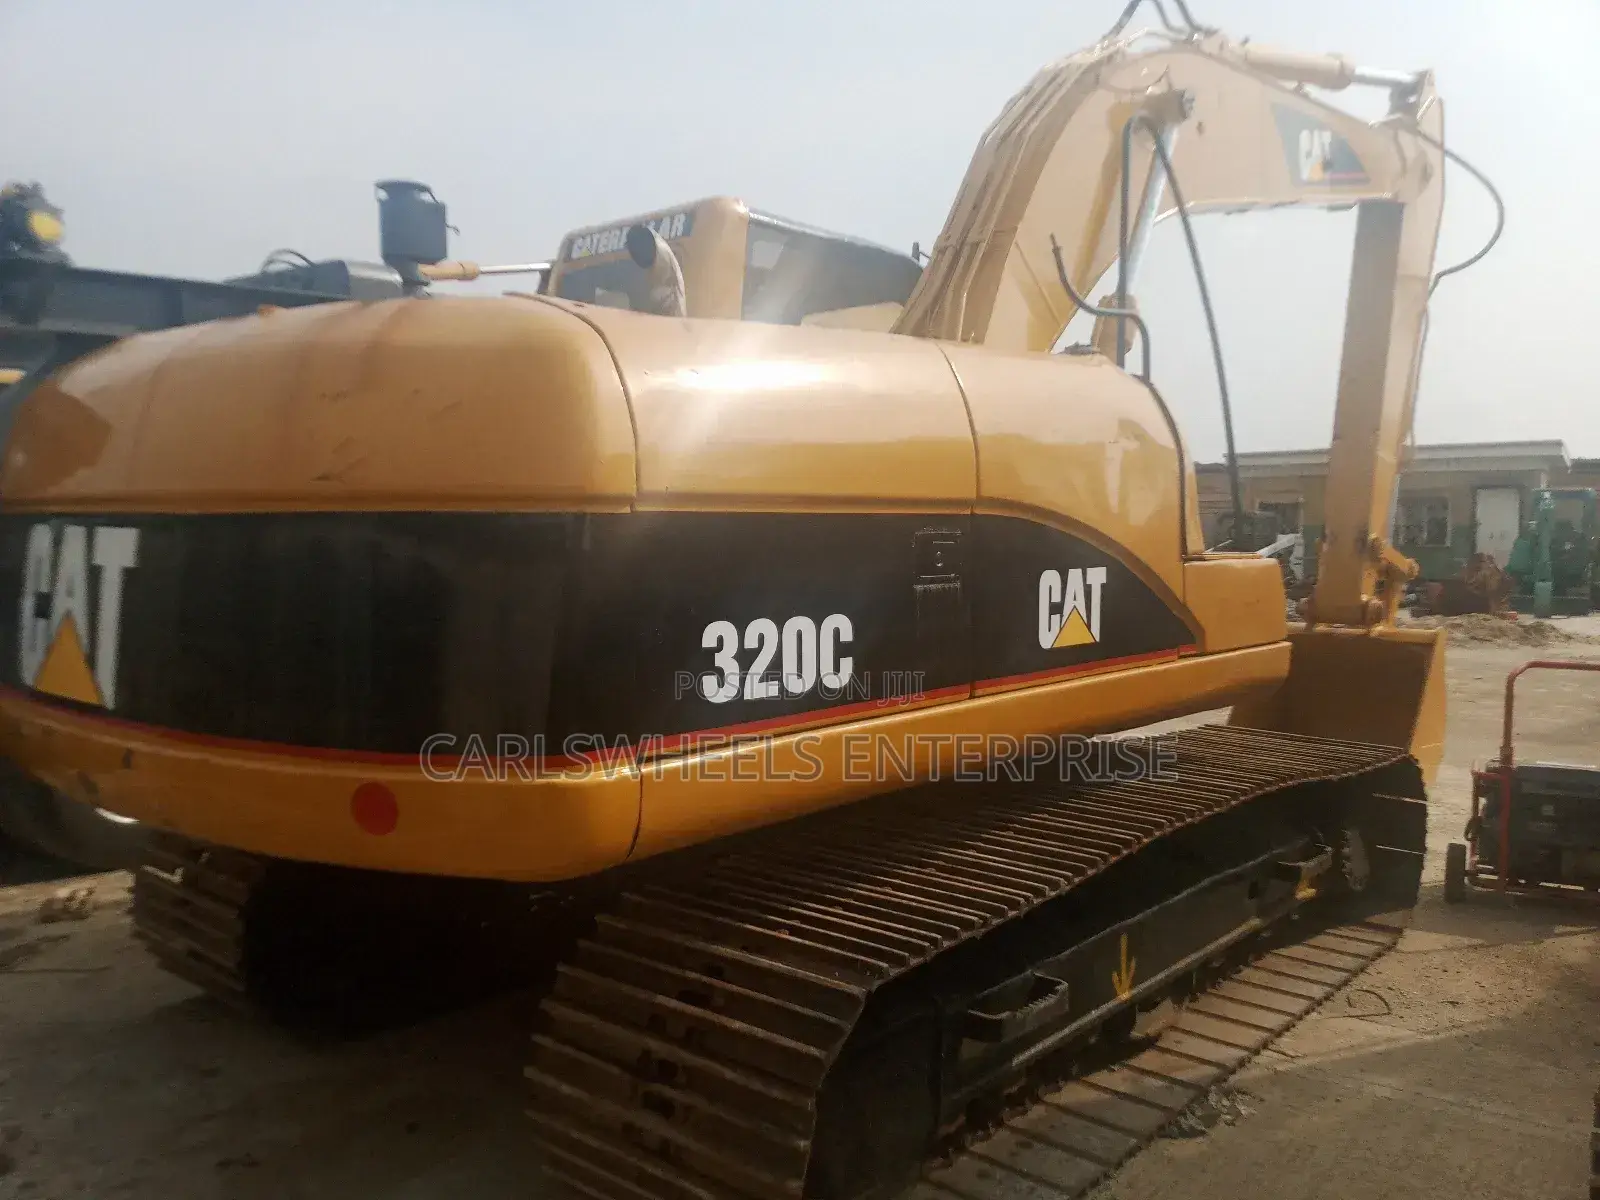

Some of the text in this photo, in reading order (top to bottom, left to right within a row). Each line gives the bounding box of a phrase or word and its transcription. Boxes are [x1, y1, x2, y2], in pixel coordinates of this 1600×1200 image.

[1298, 129, 1332, 181] CAT
[19, 523, 140, 710] CAT
[1038, 567, 1107, 650] CAT
[702, 613, 853, 703] 320C
